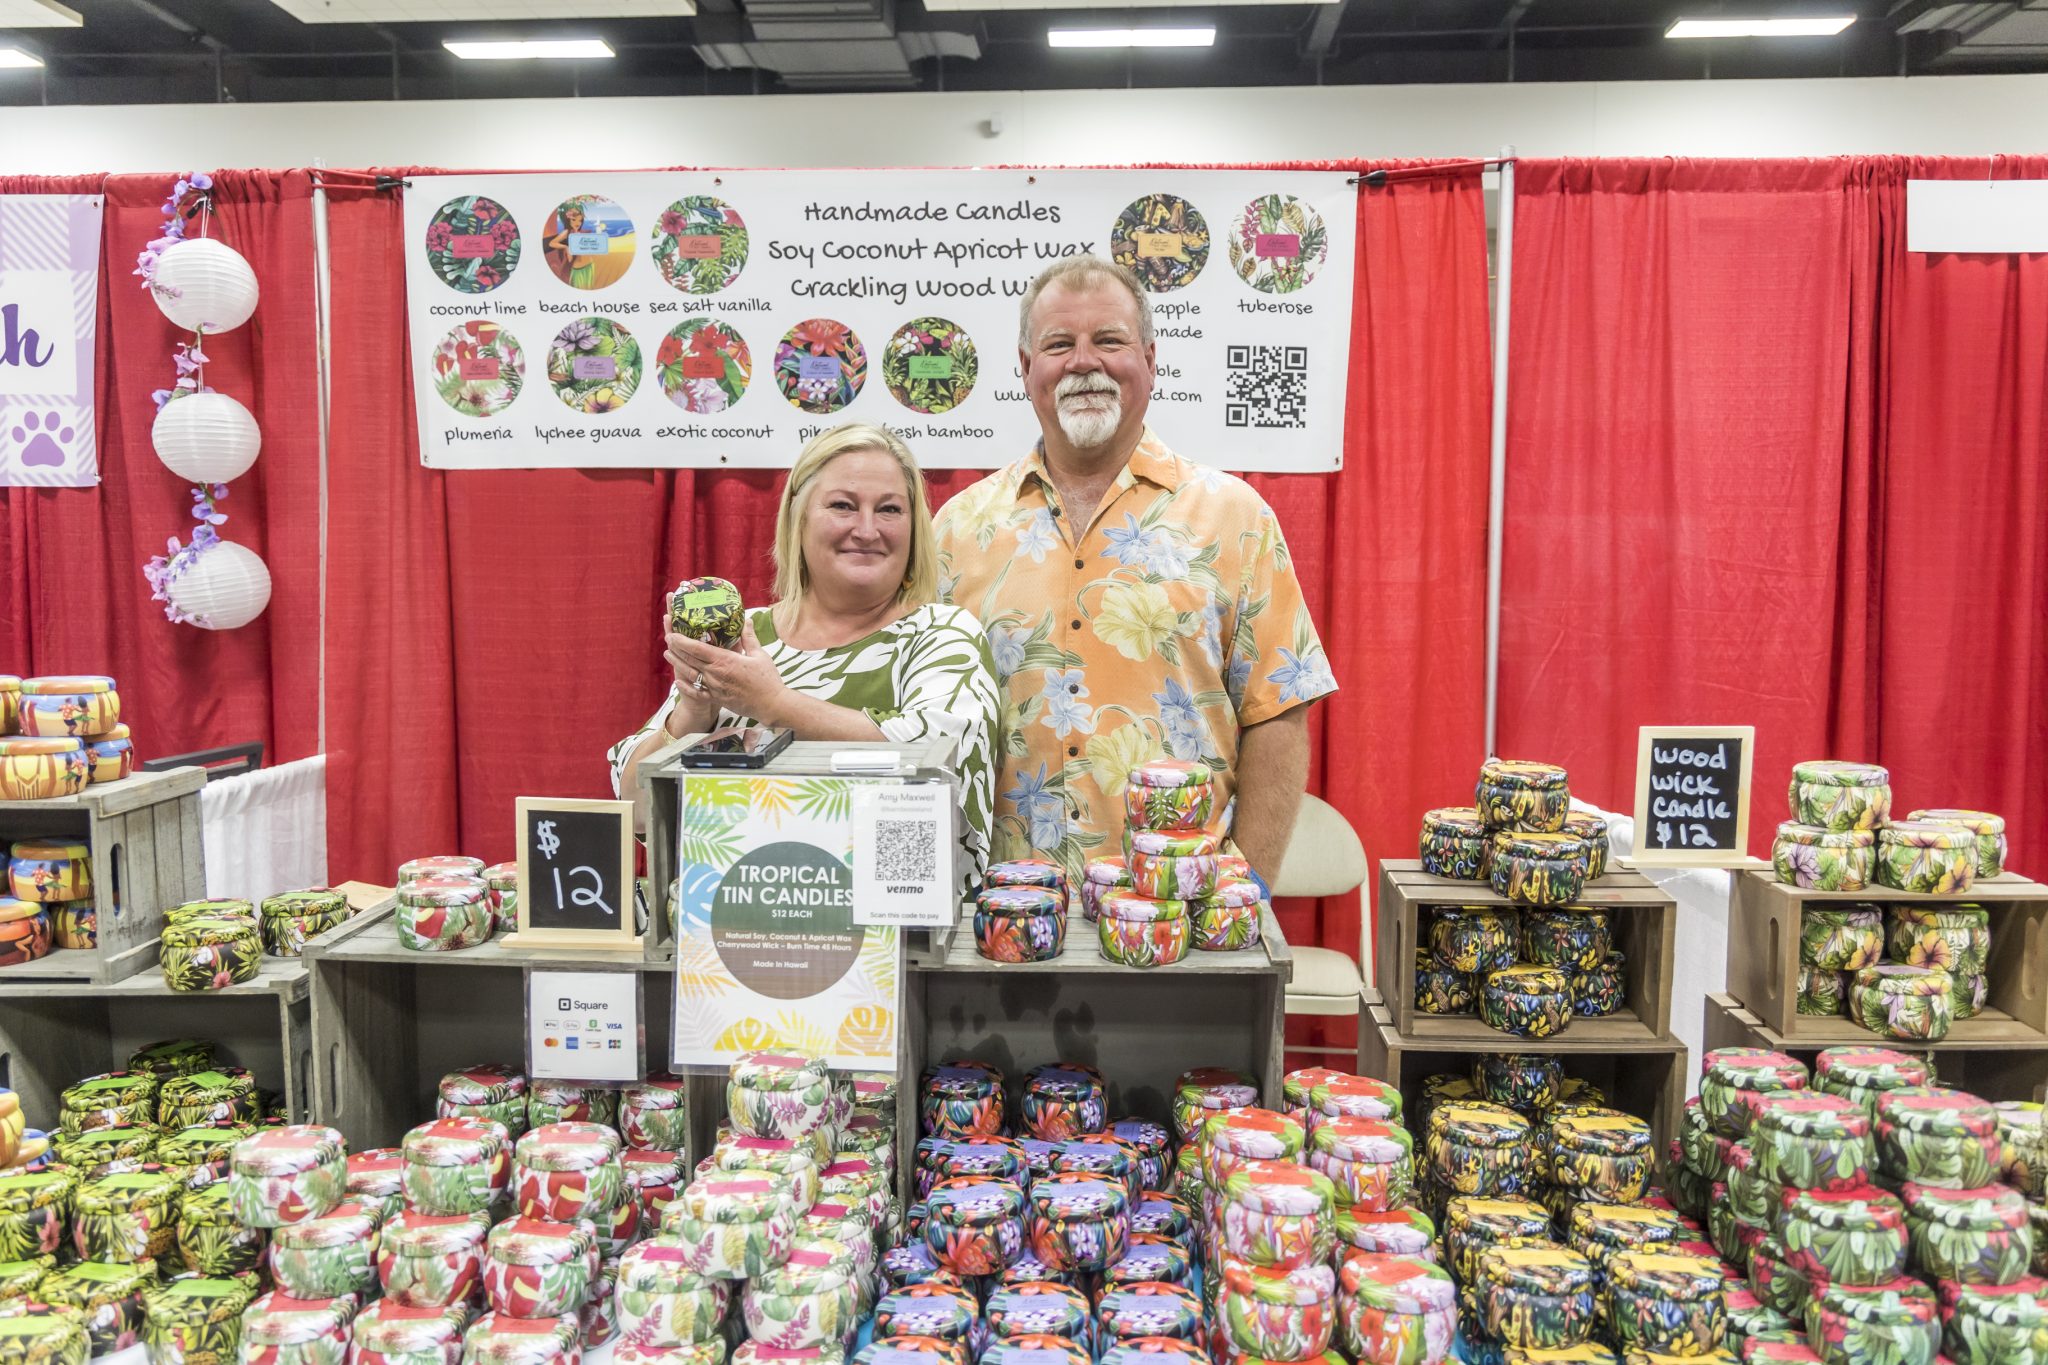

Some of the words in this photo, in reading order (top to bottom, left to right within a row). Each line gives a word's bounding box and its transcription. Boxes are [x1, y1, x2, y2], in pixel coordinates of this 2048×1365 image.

[804, 201, 949, 223] Handmade
[955, 200, 1062, 223] Candles
[768, 240, 815, 269] Soy
[822, 238, 928, 260] Coconut
[933, 238, 1029, 268] Apricot
[1035, 241, 1096, 258] Wax
[791, 276, 908, 306] Crackling
[915, 277, 997, 297] Wood
[429, 301, 492, 316] coconut
[494, 300, 528, 315] lime
[539, 300, 588, 314] beach
[593, 301, 641, 314] house
[649, 301, 678, 313] sea
[682, 299, 714, 313] salt
[717, 298, 772, 312] vanilla
[1152, 300, 1201, 320] apple
[1236, 298, 1314, 315] tuberose
[445, 426, 513, 445] plumeria
[534, 425, 586, 440] lychee
[590, 427, 643, 444] guava
[656, 424, 709, 438] exotic
[712, 425, 775, 439] coconut
[927, 424, 994, 439] bamboo
[1654, 743, 1727, 769] wood
[1651, 771, 1720, 795] wick
[537, 820, 561, 860] $
[738, 864, 840, 885] TROPICAL
[553, 865, 614, 914] 12
[721, 886, 753, 904] TIN
[759, 886, 853, 907] CANDLES
[886, 885, 924, 894] venmo
[788, 909, 813, 918] EACH
[869, 911, 887, 919] Scan
[716, 940, 761, 950] Cherrywood
[762, 941, 779, 949] Wick
[786, 942, 802, 950] Burn
[803, 943, 820, 951] Time
[725, 932, 752, 940] Natural
[752, 932, 768, 942] Soy,
[769, 933, 801, 941] Coconut
[808, 933, 835, 943] Apricot
[752, 960, 774, 968] Made
[784, 961, 809, 969] Hawaii
[573, 1000, 609, 1012] Square
